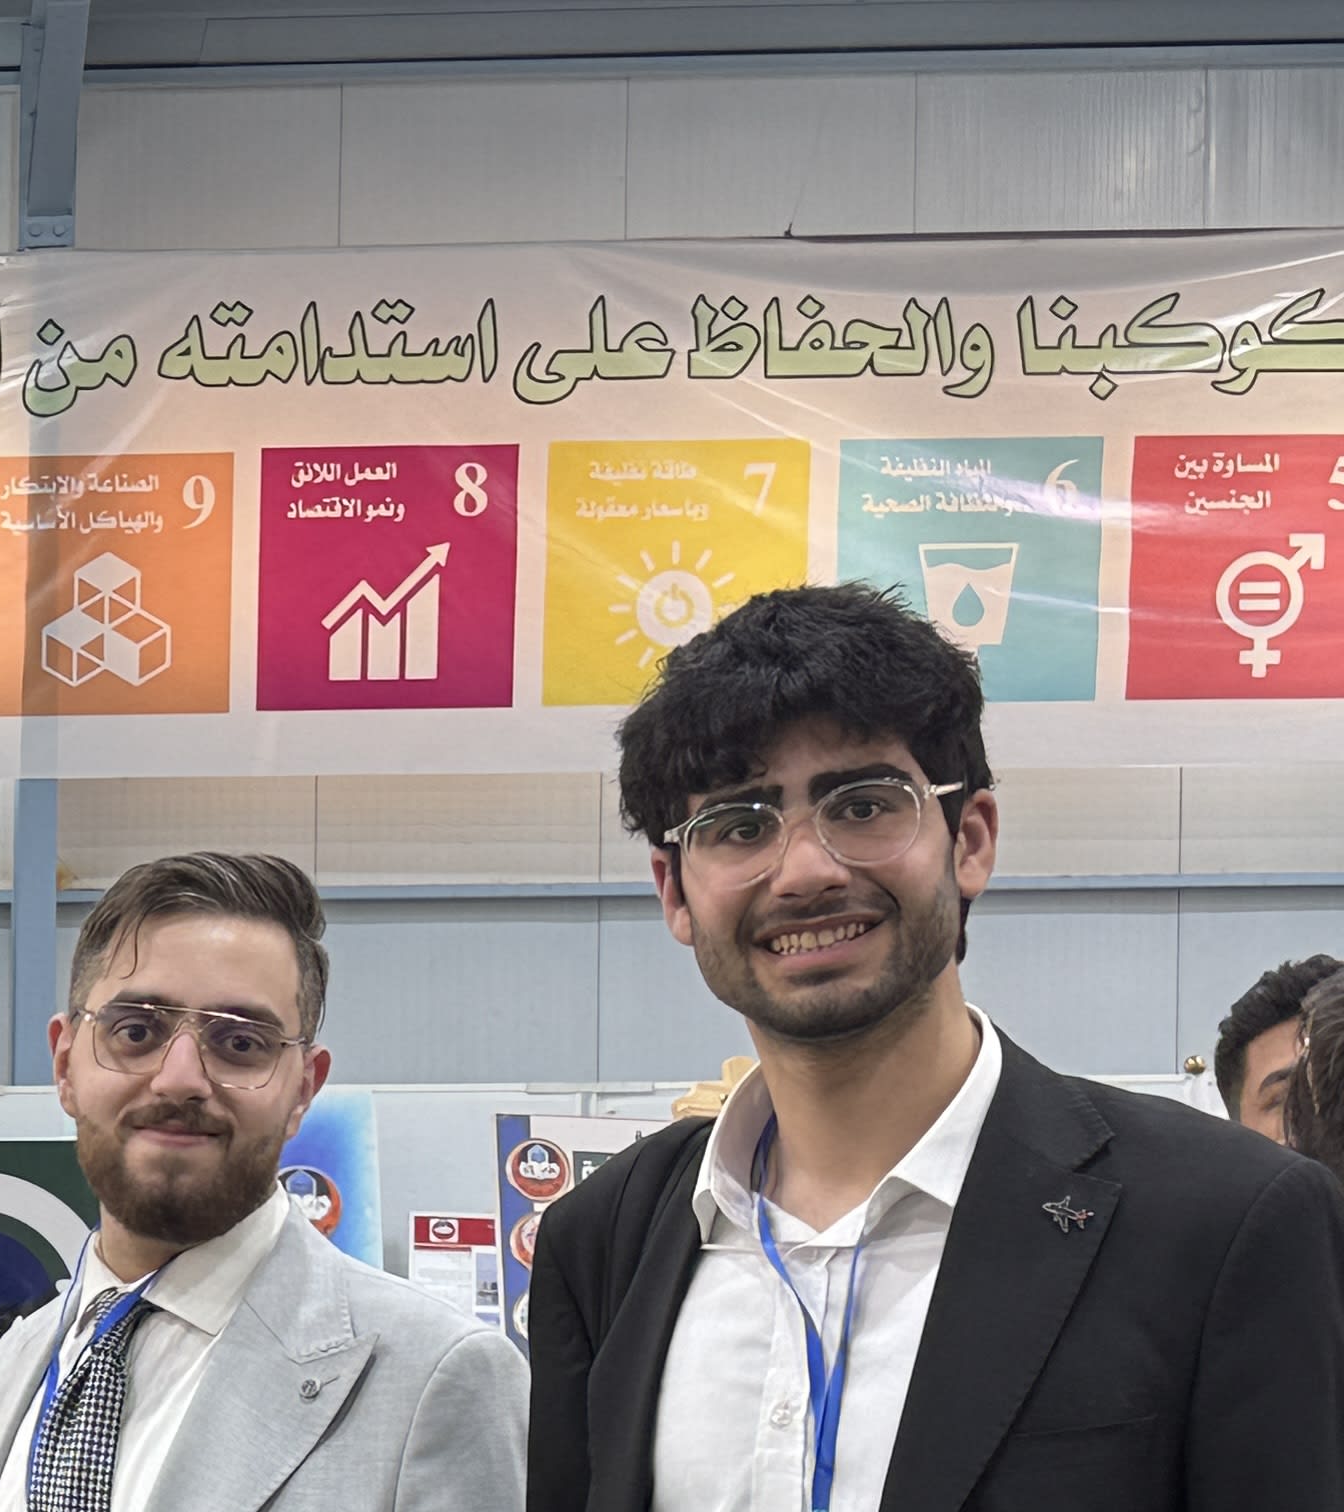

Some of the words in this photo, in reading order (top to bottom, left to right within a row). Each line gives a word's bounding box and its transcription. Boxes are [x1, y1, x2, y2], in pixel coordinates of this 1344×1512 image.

[23, 318, 137, 417] من
[159, 297, 498, 388] استدامته
[513, 294, 673, 404] على
[688, 294, 994, 399] والحفاظ
[88, 473, 159, 494] الصناعة
[344, 461, 397, 487] العمل
[453, 461, 489, 518] 8
[743, 462, 777, 517] 7
[1174, 454, 1209, 480] بين
[182, 474, 216, 530] 9
[363, 497, 406, 523] ونمو
[1184, 489, 1271, 516] الجنسين
